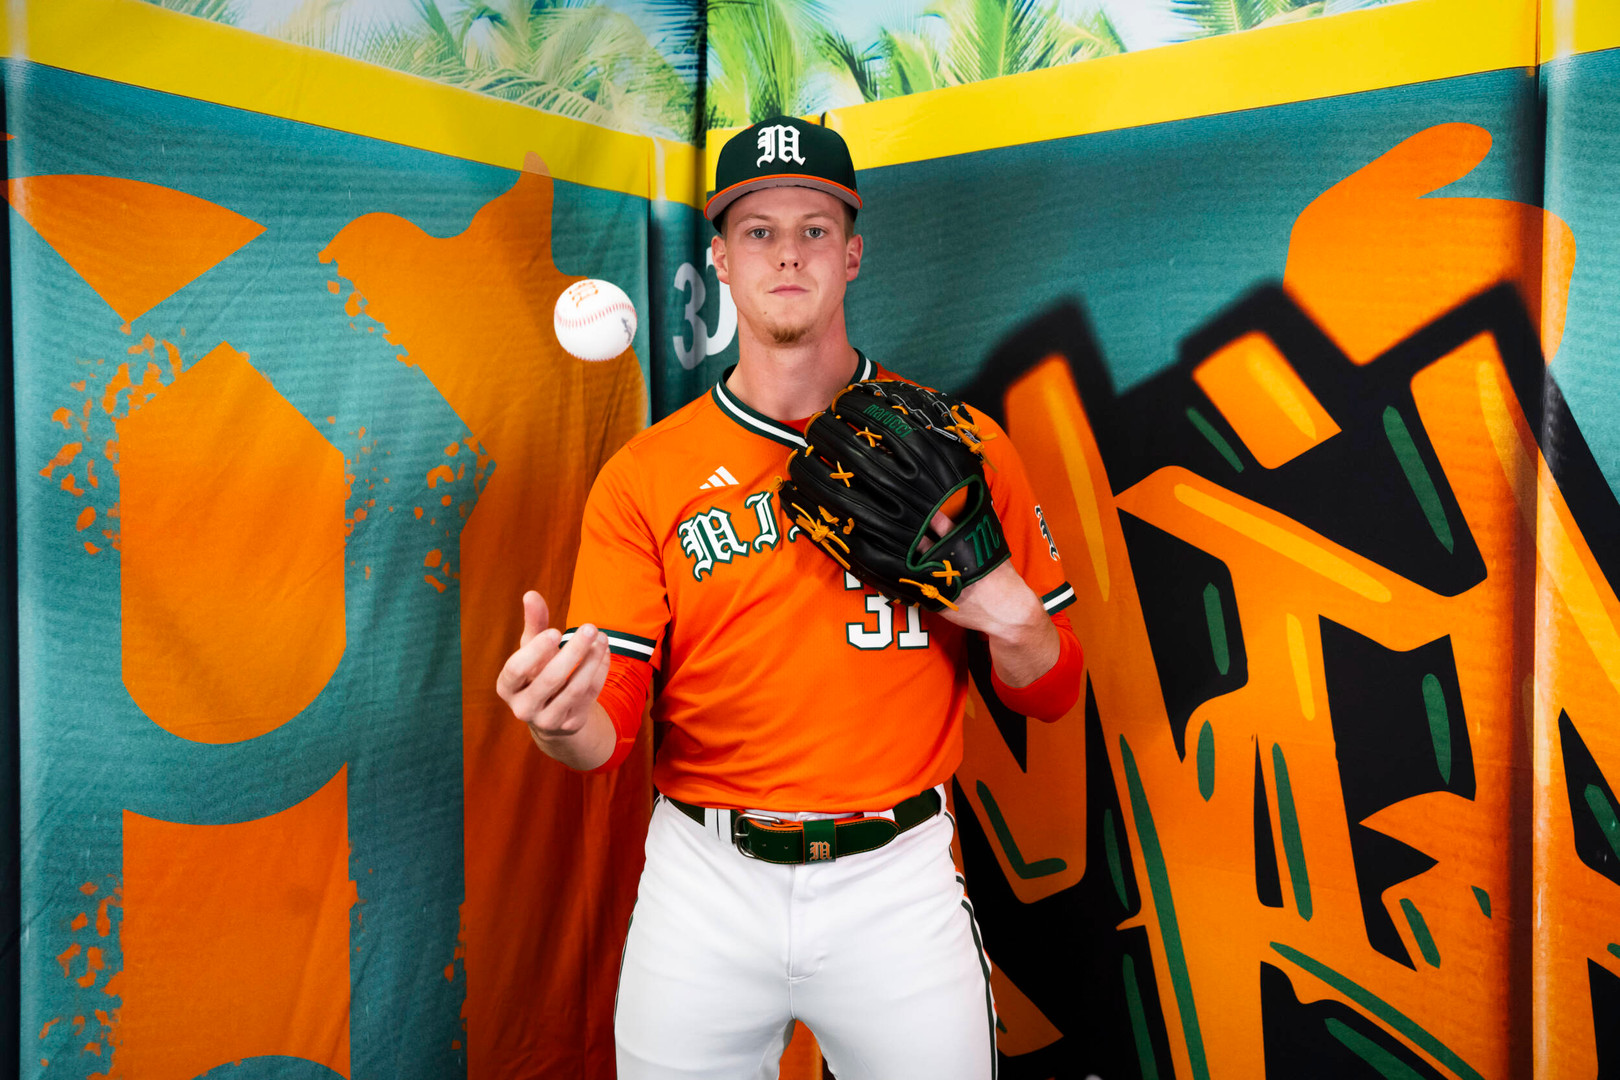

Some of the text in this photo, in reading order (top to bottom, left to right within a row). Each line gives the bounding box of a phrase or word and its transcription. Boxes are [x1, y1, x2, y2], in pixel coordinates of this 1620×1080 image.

[756, 124, 806, 168] M
[678, 491, 801, 582] MI
[844, 570, 930, 651] 31
[809, 841, 833, 862] M
